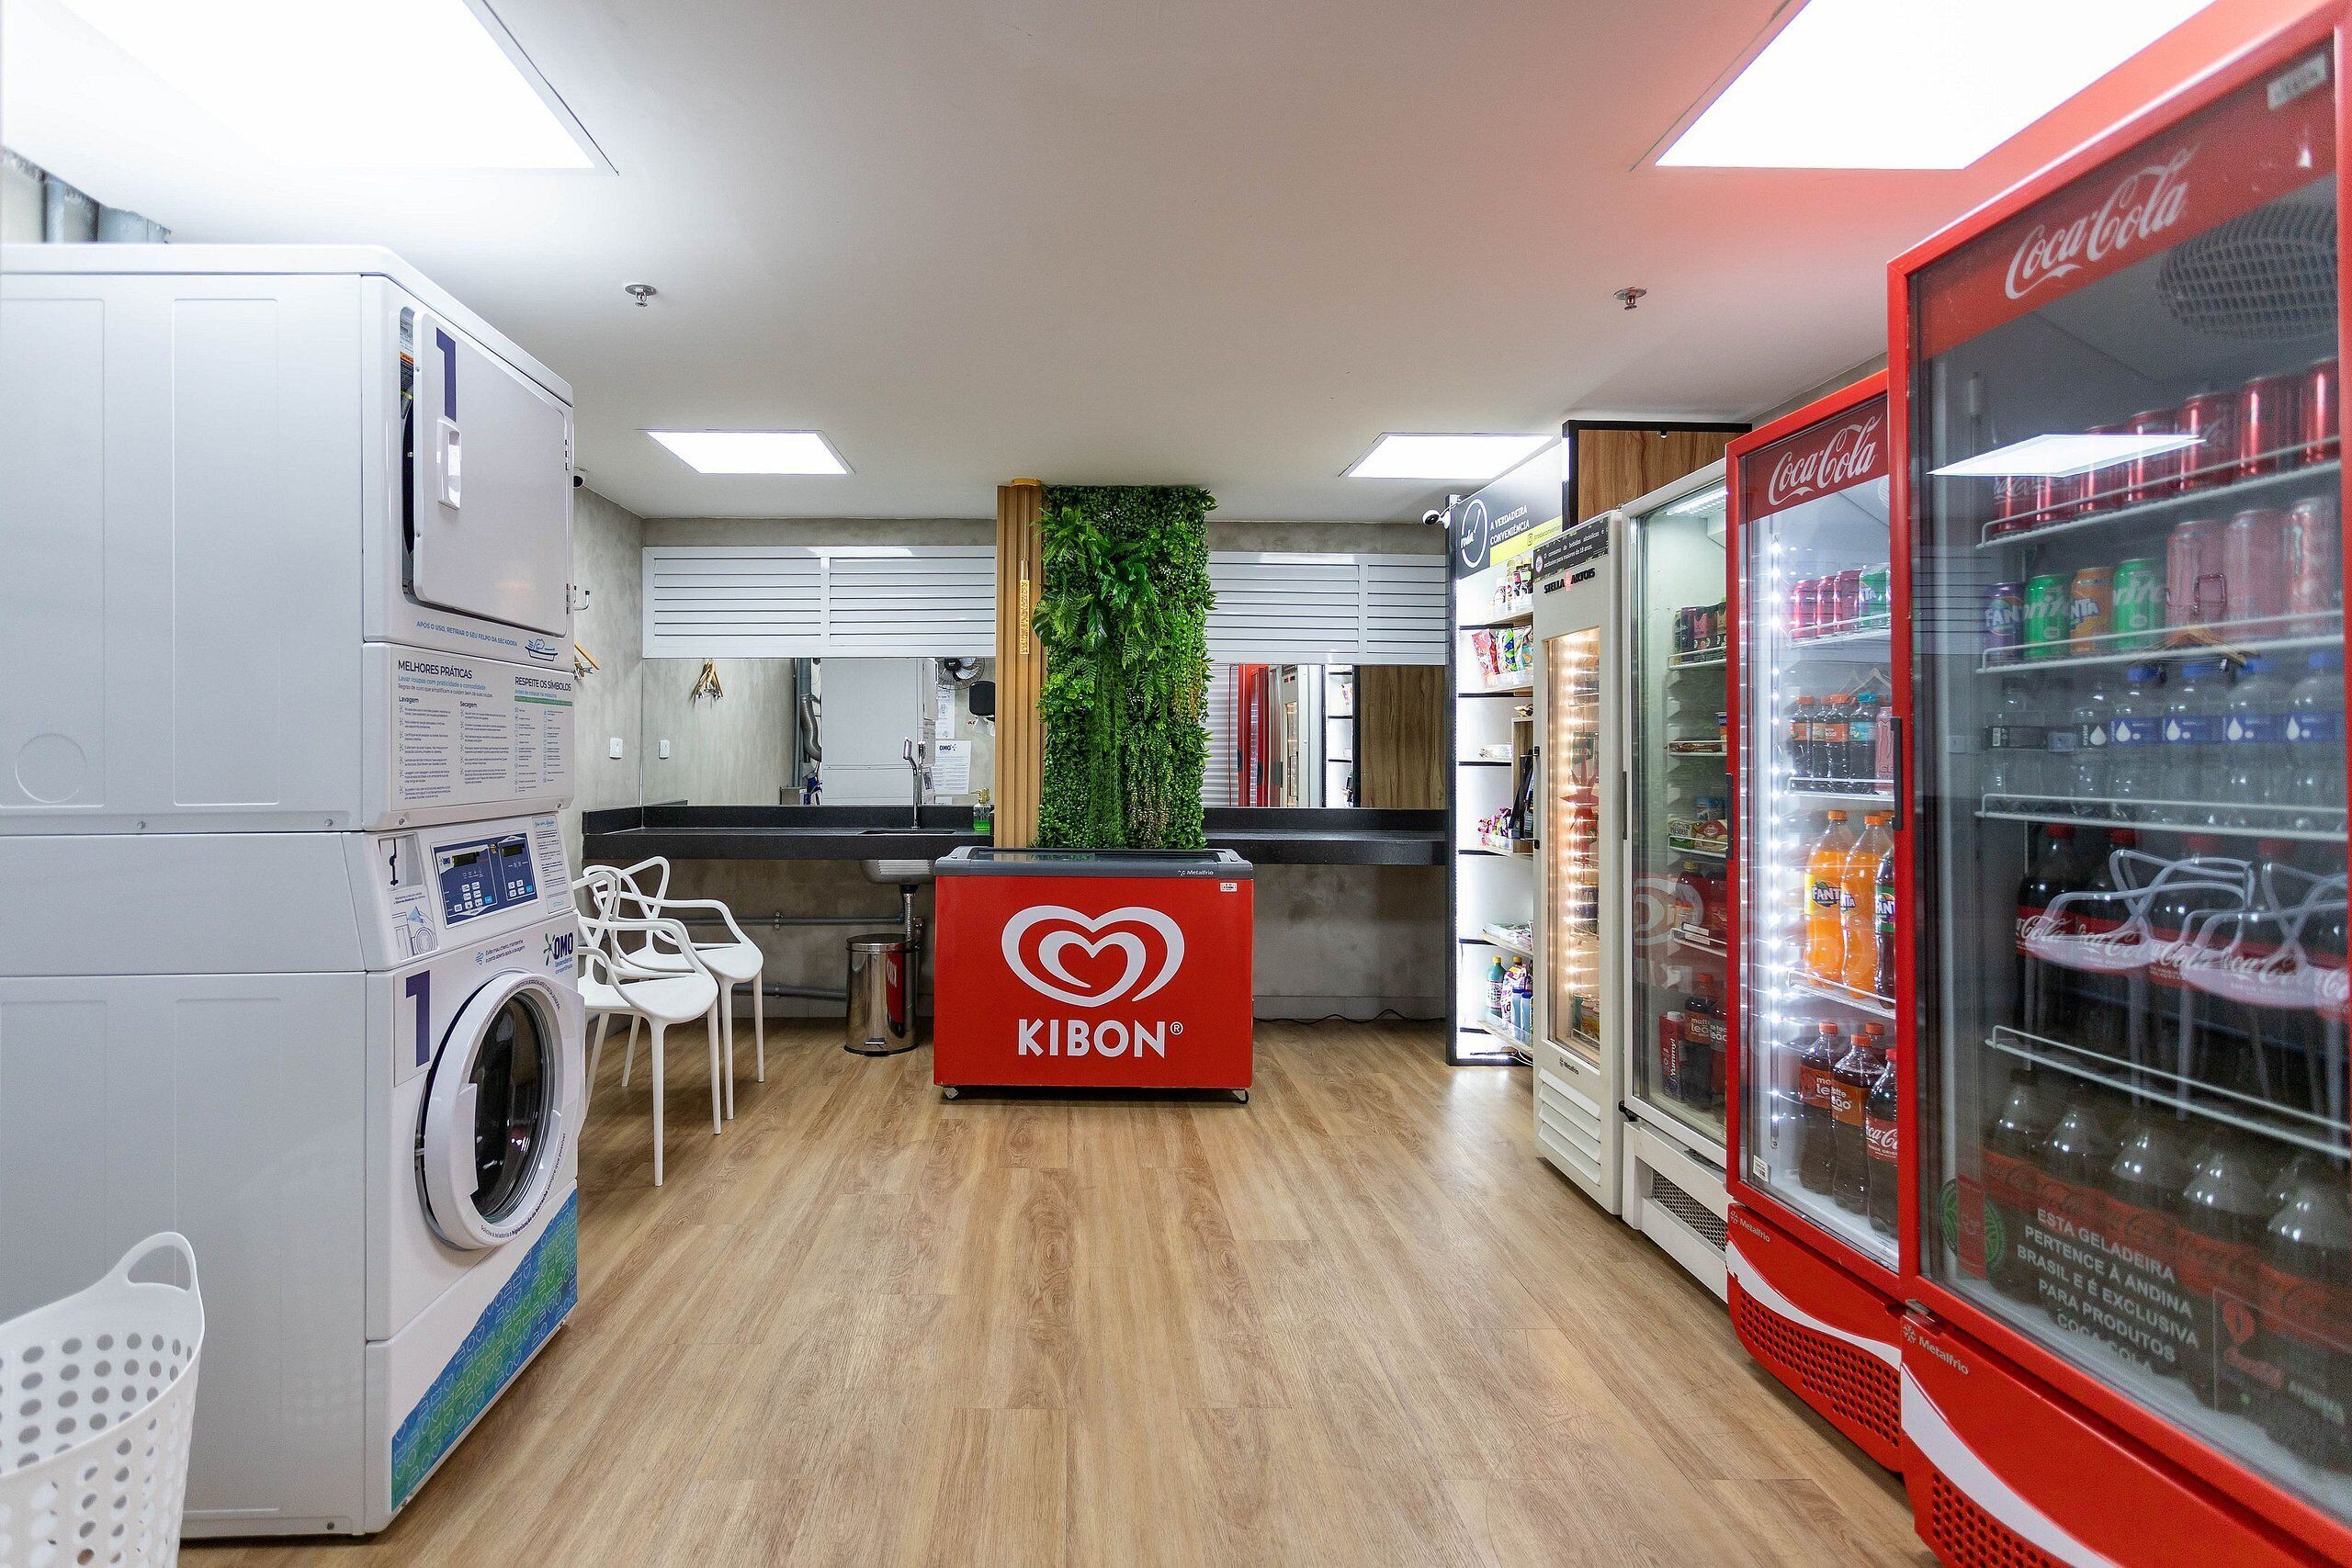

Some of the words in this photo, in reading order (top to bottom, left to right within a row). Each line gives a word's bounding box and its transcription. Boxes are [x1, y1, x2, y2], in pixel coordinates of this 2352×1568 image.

[2005, 142, 2199, 299] Coca-Cola
[436, 327, 457, 423] 1
[1769, 413, 1883, 505] Coca-Cola
[1495, 505, 1528, 528] VERDADEIRA
[1490, 519, 1530, 546] CONVENIÊNCIA
[1544, 579, 1565, 594] STELLA
[1571, 568, 1596, 584] ARTOIS
[2071, 598, 2100, 619] NTA
[447, 626, 465, 637] RETIRAR
[497, 637, 517, 647] SECADORA
[398, 660, 439, 675] MELHORES
[440, 665, 472, 680] PRÁTICAS
[514, 676, 539, 688] RESPEITE
[540, 680, 547, 689] OS
[548, 680, 571, 691] SÍMBOLOS
[399, 696, 419, 705] Lavagem
[459, 701, 478, 709] Secagem
[1812, 887, 1840, 901] FANT
[1841, 894, 1856, 907] NTA
[553, 932, 574, 960] OMO
[405, 969, 431, 1067] 1
[1739, 1218, 1770, 1243] Metalfrio
[2037, 1209, 2075, 1237] ESTA
[2078, 1226, 2176, 1284] GELADEIRA
[2025, 1224, 2105, 1276] PERTENCE
[2124, 1273, 2192, 1319] ANDINA
[2017, 1244, 2069, 1282] BRASIL
[2073, 1272, 2084, 1290] E
[2102, 1287, 2199, 1348] EXCLUSIVA
[2039, 1278, 2079, 1312] PARA
[2082, 1302, 2175, 1362] PRODUTOS
[1919, 1336, 1969, 1375] Metalfrio
